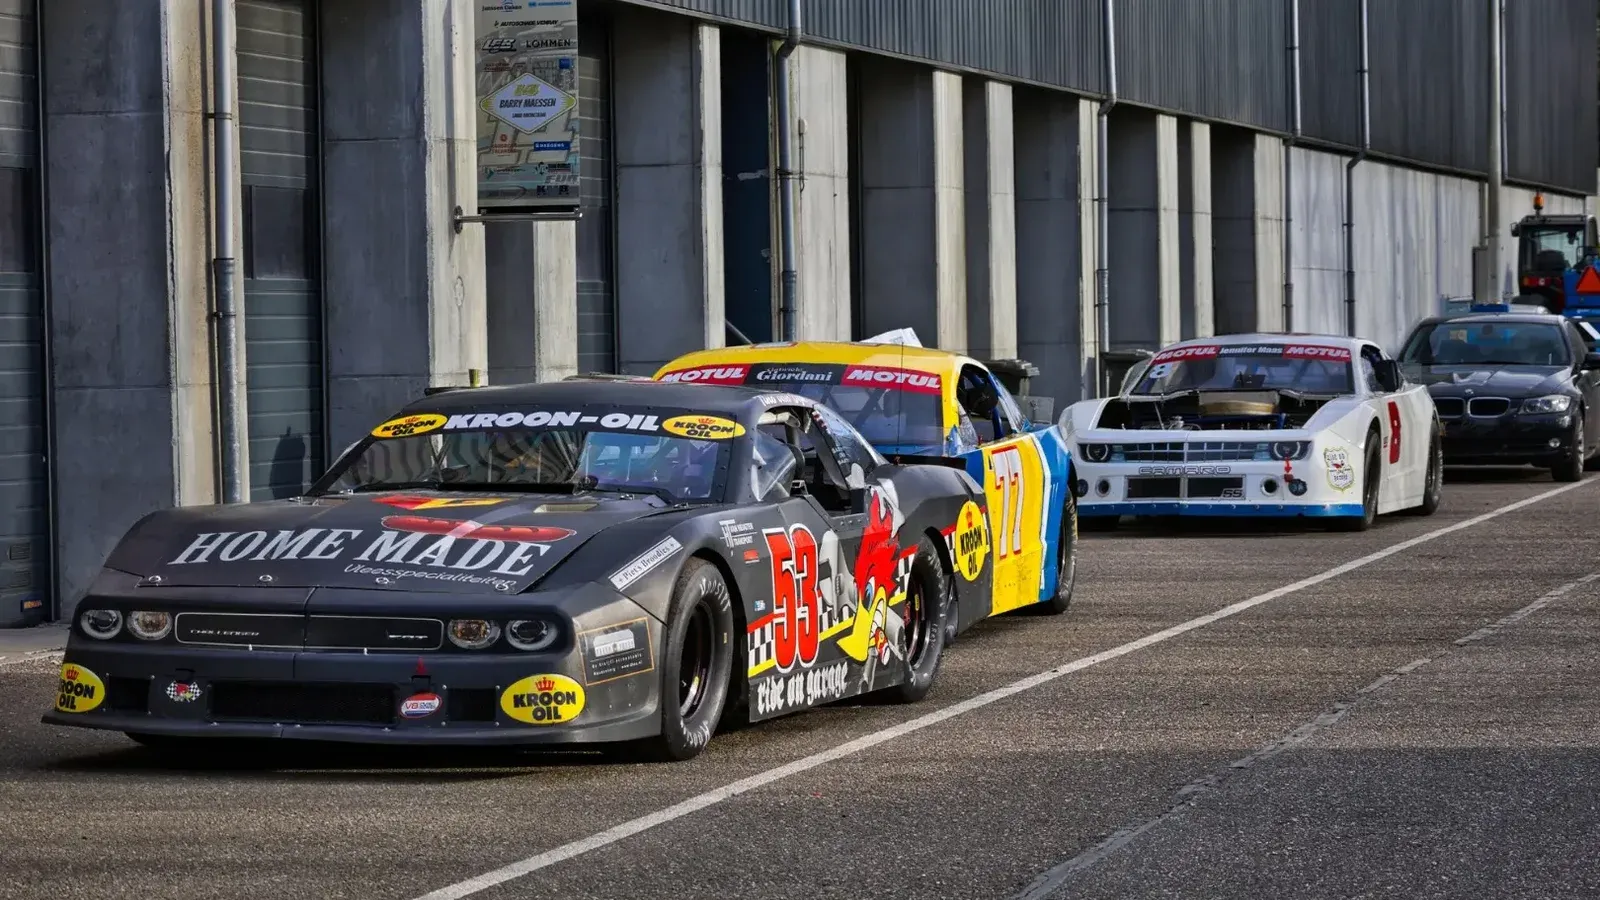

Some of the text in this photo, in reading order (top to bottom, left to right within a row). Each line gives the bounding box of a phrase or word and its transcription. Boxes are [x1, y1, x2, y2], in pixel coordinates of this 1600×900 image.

[526, 39, 571, 48] LOMMEN
[499, 98, 557, 109] BARRY MAESSEN
[1156, 346, 1217, 361] MOTUL
[1286, 346, 1350, 358] MOTUL
[661, 367, 745, 382] MOTUL
[756, 370, 833, 381] Giordani
[847, 369, 941, 388] MOTUL
[380, 418, 437, 433] KROON
[443, 411, 660, 432] KROON-OIL
[672, 420, 735, 434] KROON
[391, 427, 417, 437] OIL
[686, 428, 712, 438] OIL
[1139, 466, 1232, 475] CAMARO
[991, 445, 1024, 560] 77
[960, 525, 983, 557] KROON
[167, 528, 552, 576] HOME MADE
[967, 551, 978, 577] OIL
[762, 523, 820, 674] 53
[757, 661, 849, 716] ride on garage
[58, 692, 77, 710] OIL
[513, 690, 577, 708] KROON
[532, 706, 562, 721] OIL
